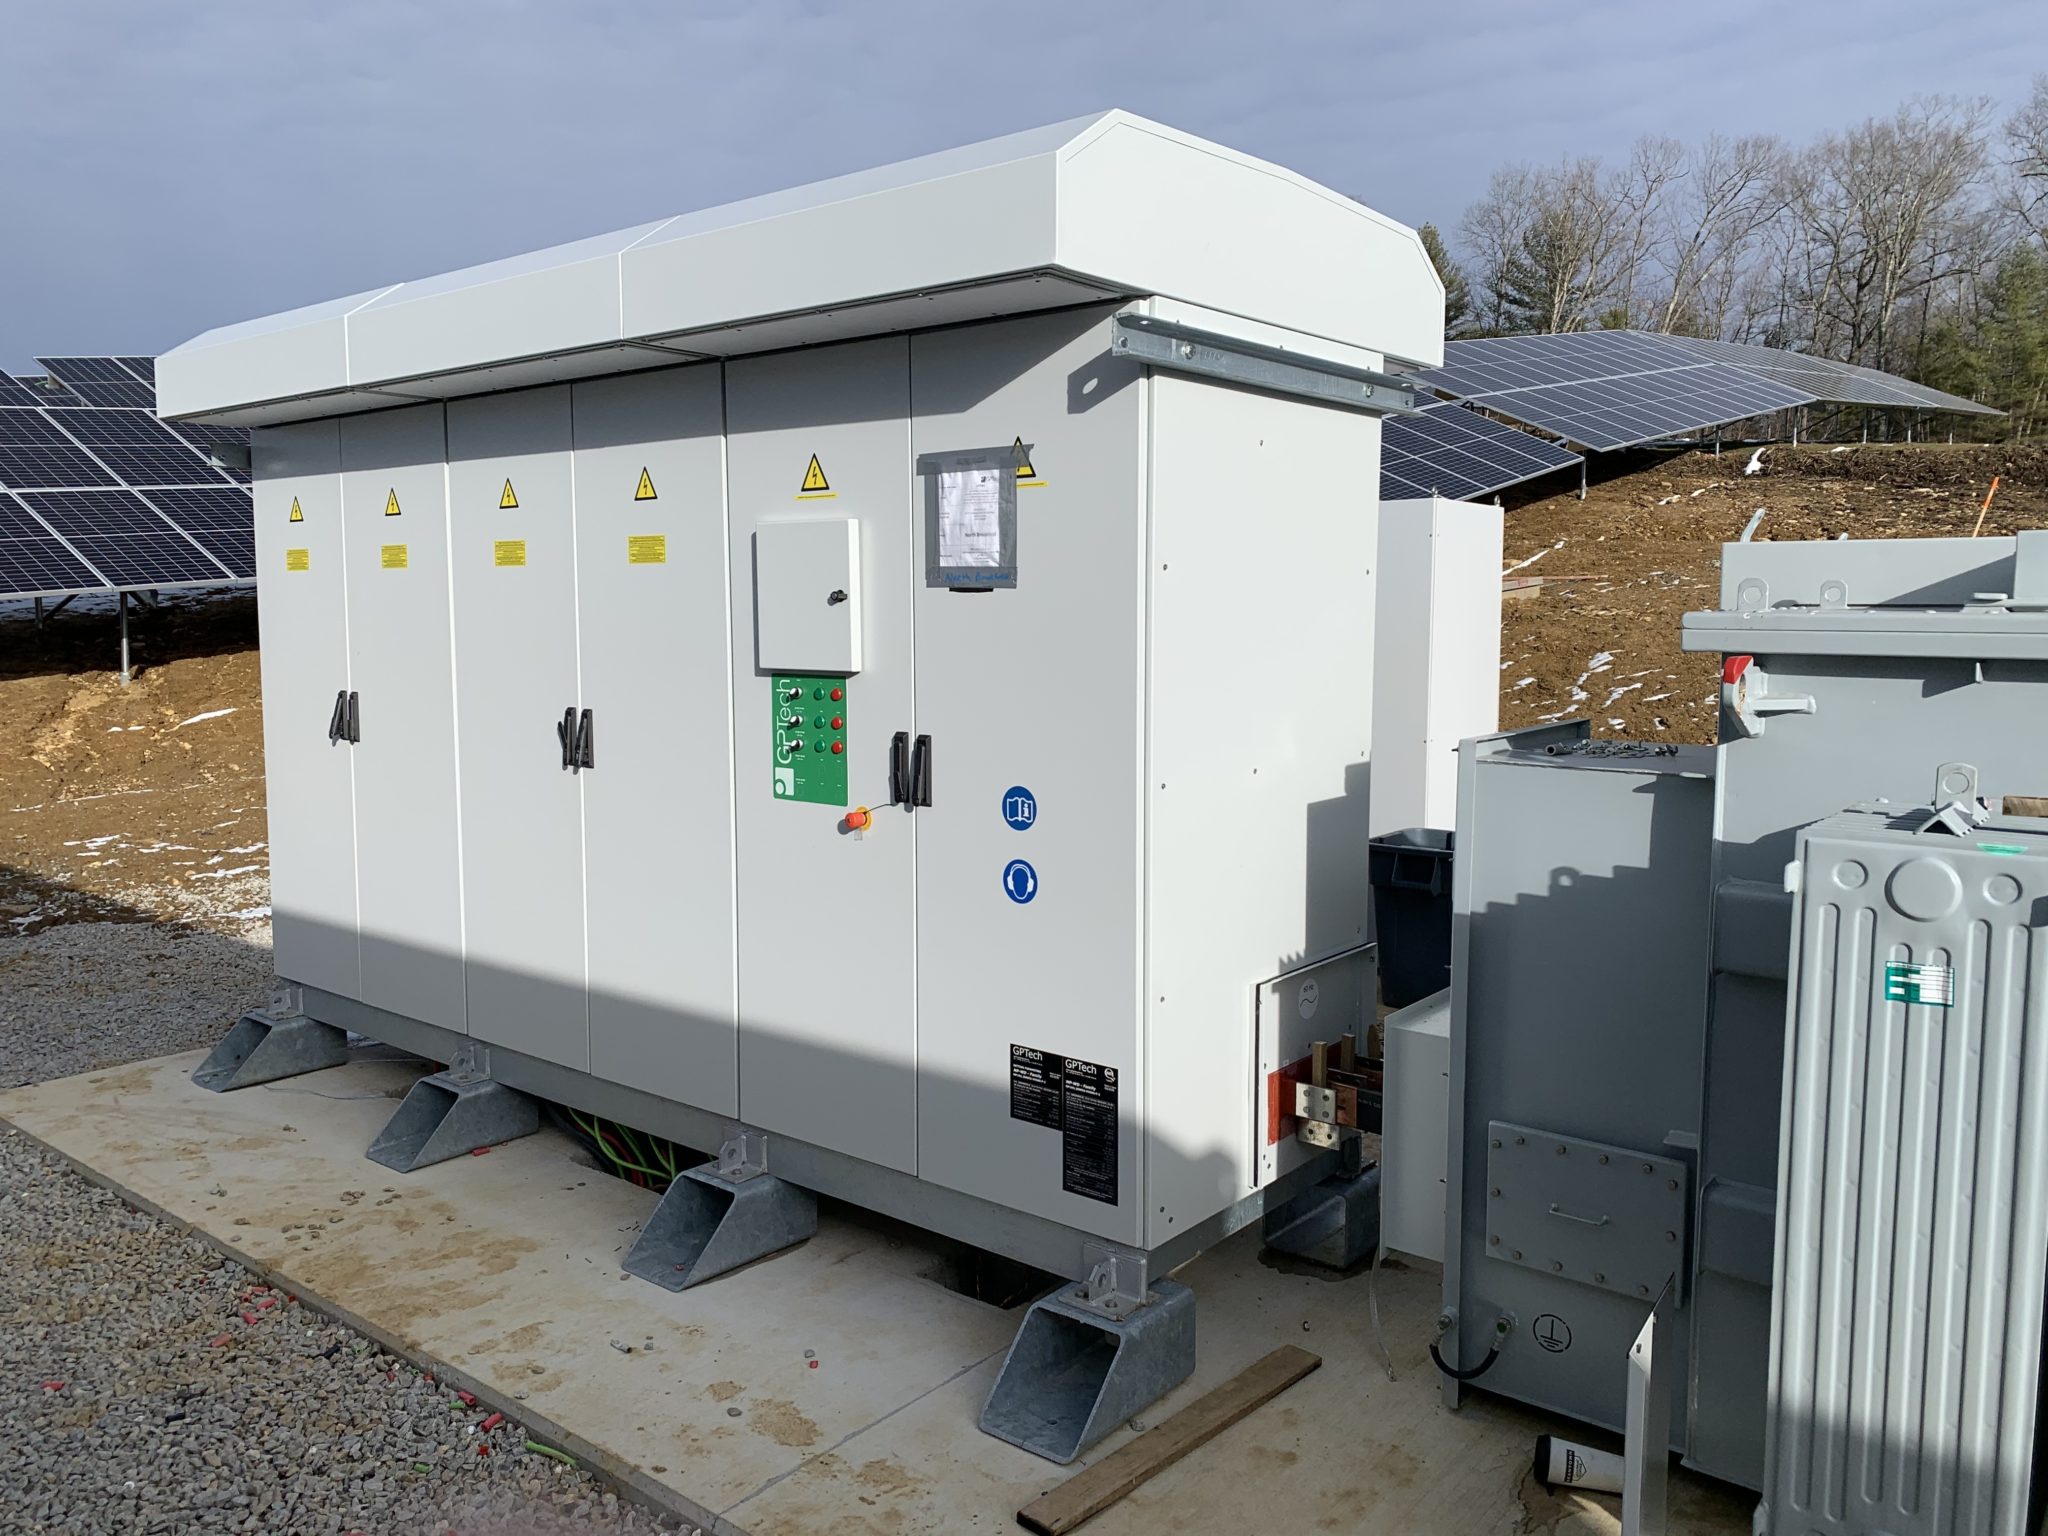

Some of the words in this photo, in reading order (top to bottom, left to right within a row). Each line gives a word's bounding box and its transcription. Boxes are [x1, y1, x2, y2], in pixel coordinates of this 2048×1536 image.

[776, 679, 792, 764] GPTech
[1013, 1046, 1042, 1061] GPTech
[1065, 1059, 1097, 1075] GPTech
